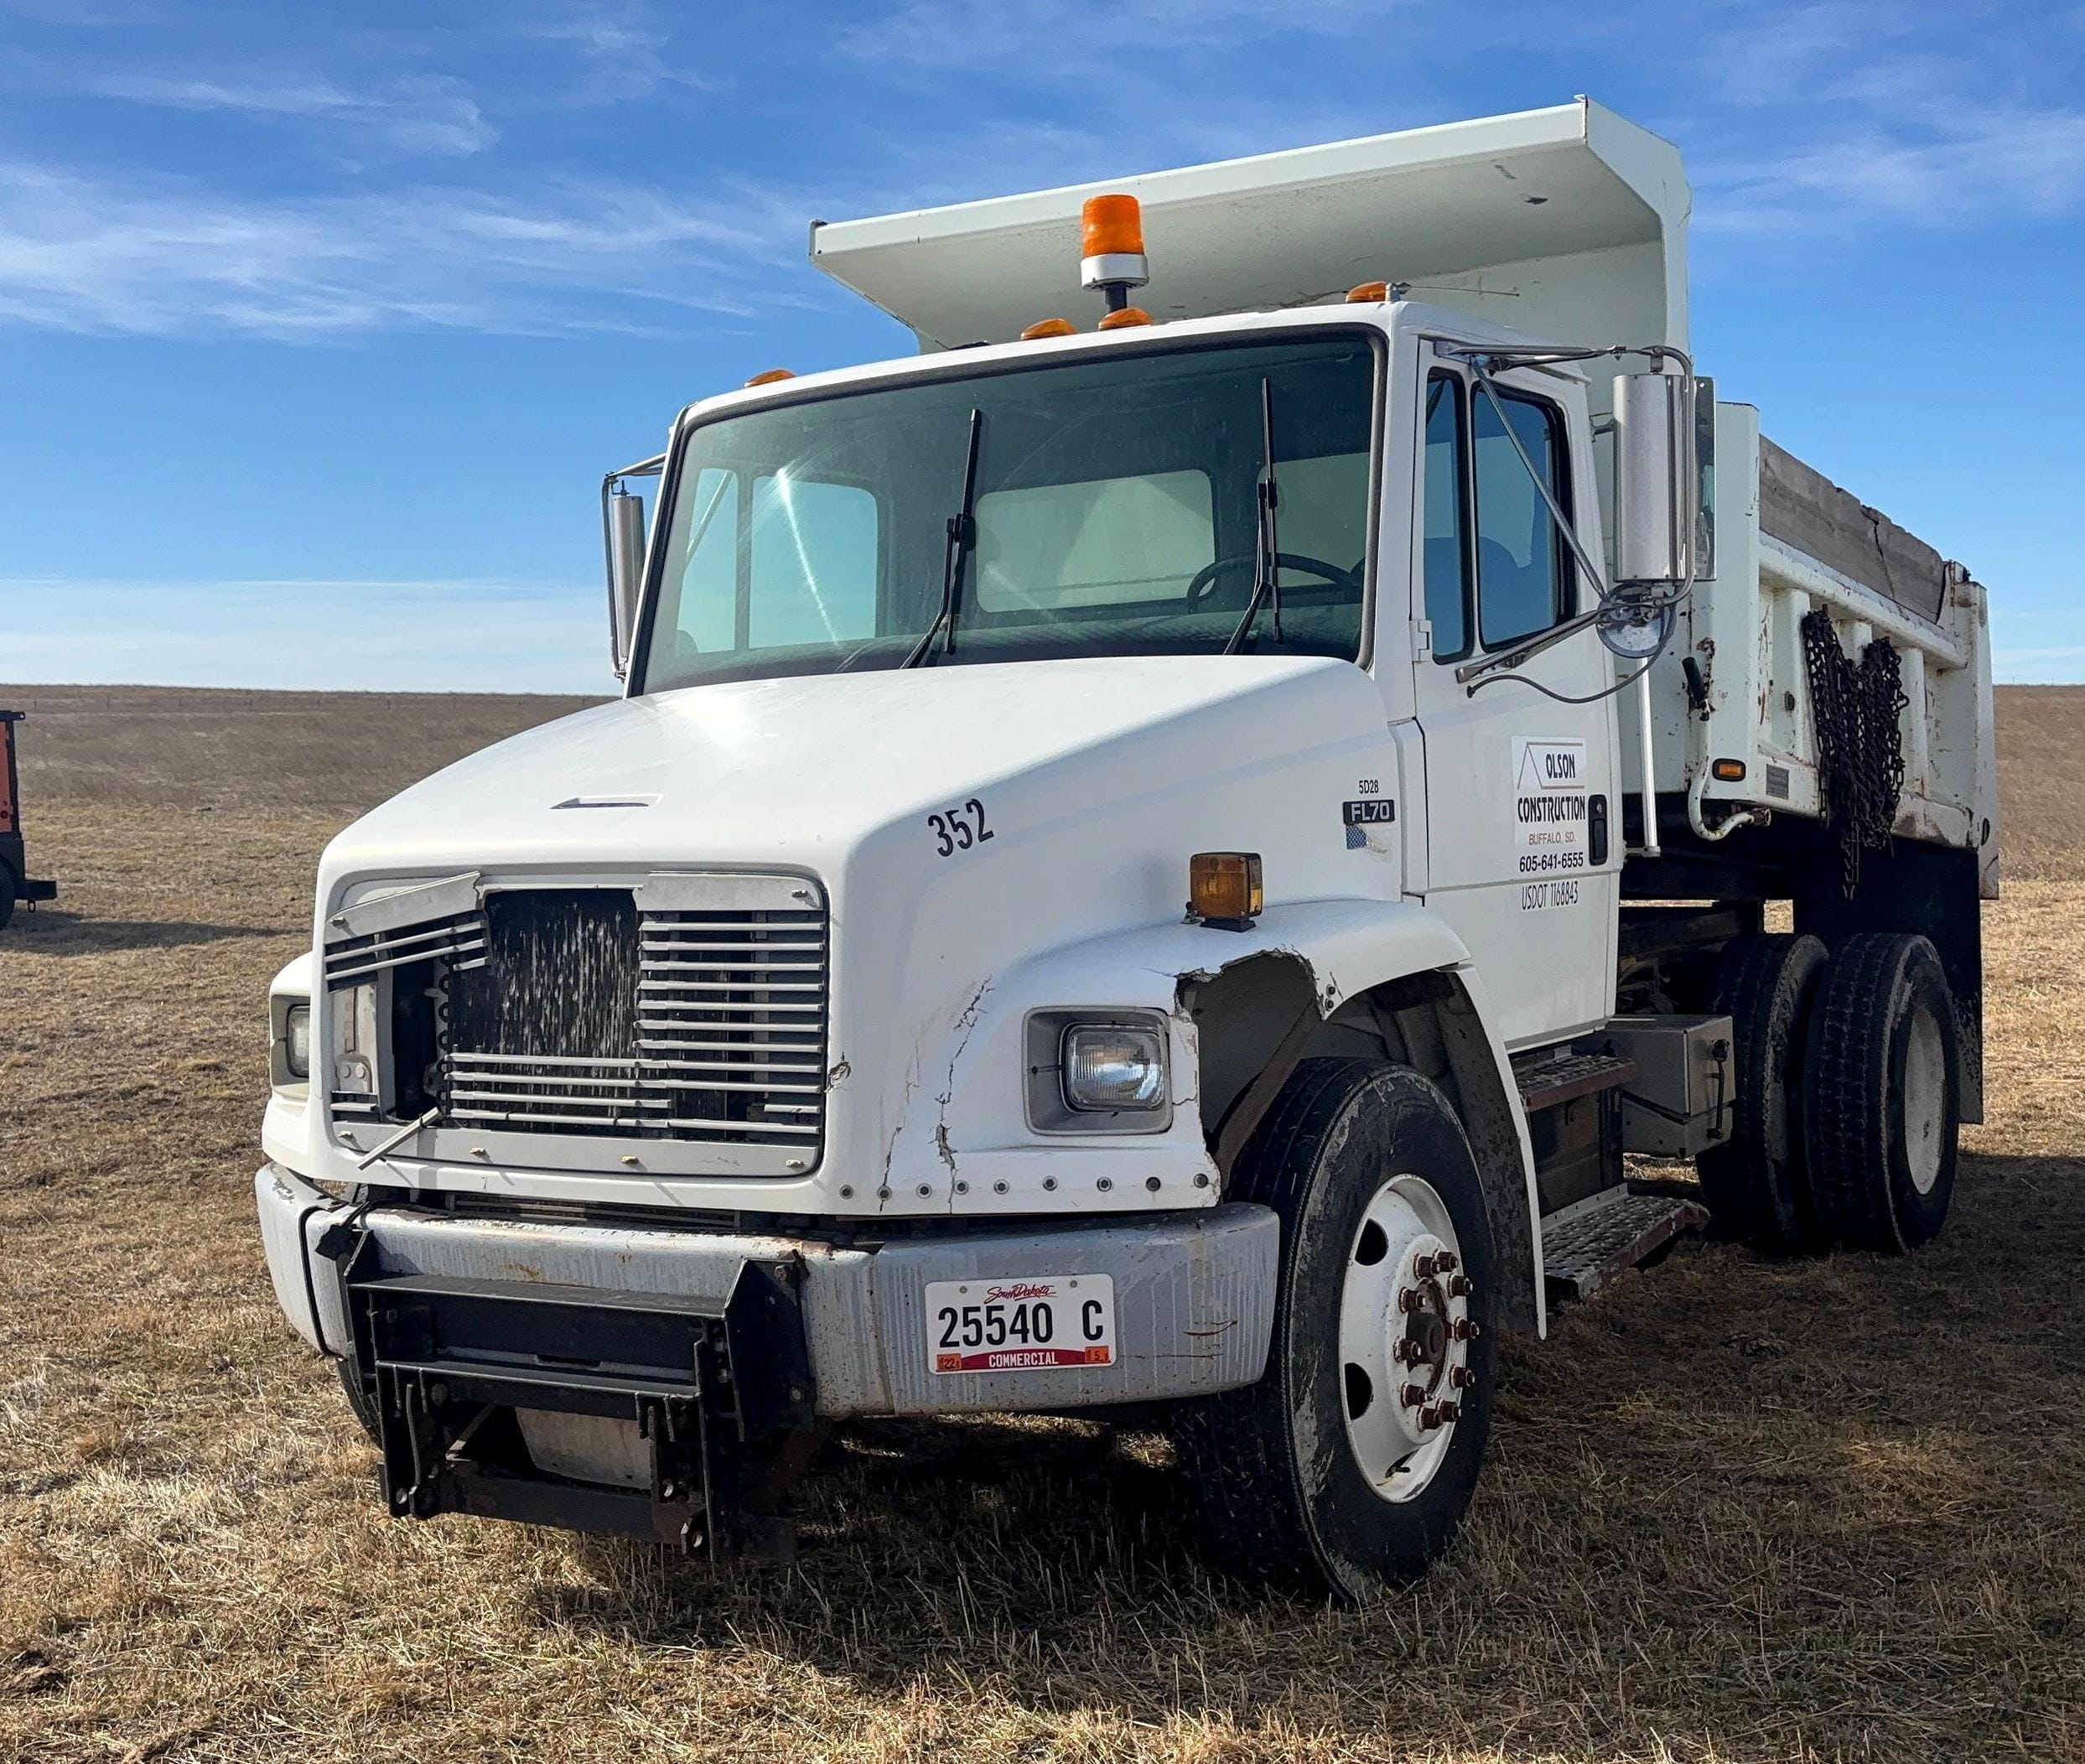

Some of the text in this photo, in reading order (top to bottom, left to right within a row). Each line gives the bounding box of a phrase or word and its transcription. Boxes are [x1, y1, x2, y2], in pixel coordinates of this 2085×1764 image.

[1545, 753, 1576, 779] OLSON
[1358, 779, 1380, 795] 5D28
[1351, 802, 1390, 822] FL70
[1517, 796, 1585, 824] CONSTRUCTION
[927, 798, 994, 857] 352
[1528, 831, 1564, 846] BUFFALO,
[1519, 851, 1584, 873] 605-641-6555
[1522, 880, 1579, 911] USDOT 1168843
[1014, 1283, 1058, 1301] Dakota
[938, 1300, 1103, 1348] 25540 C
[988, 1352, 1060, 1368] COMMERCIAL
